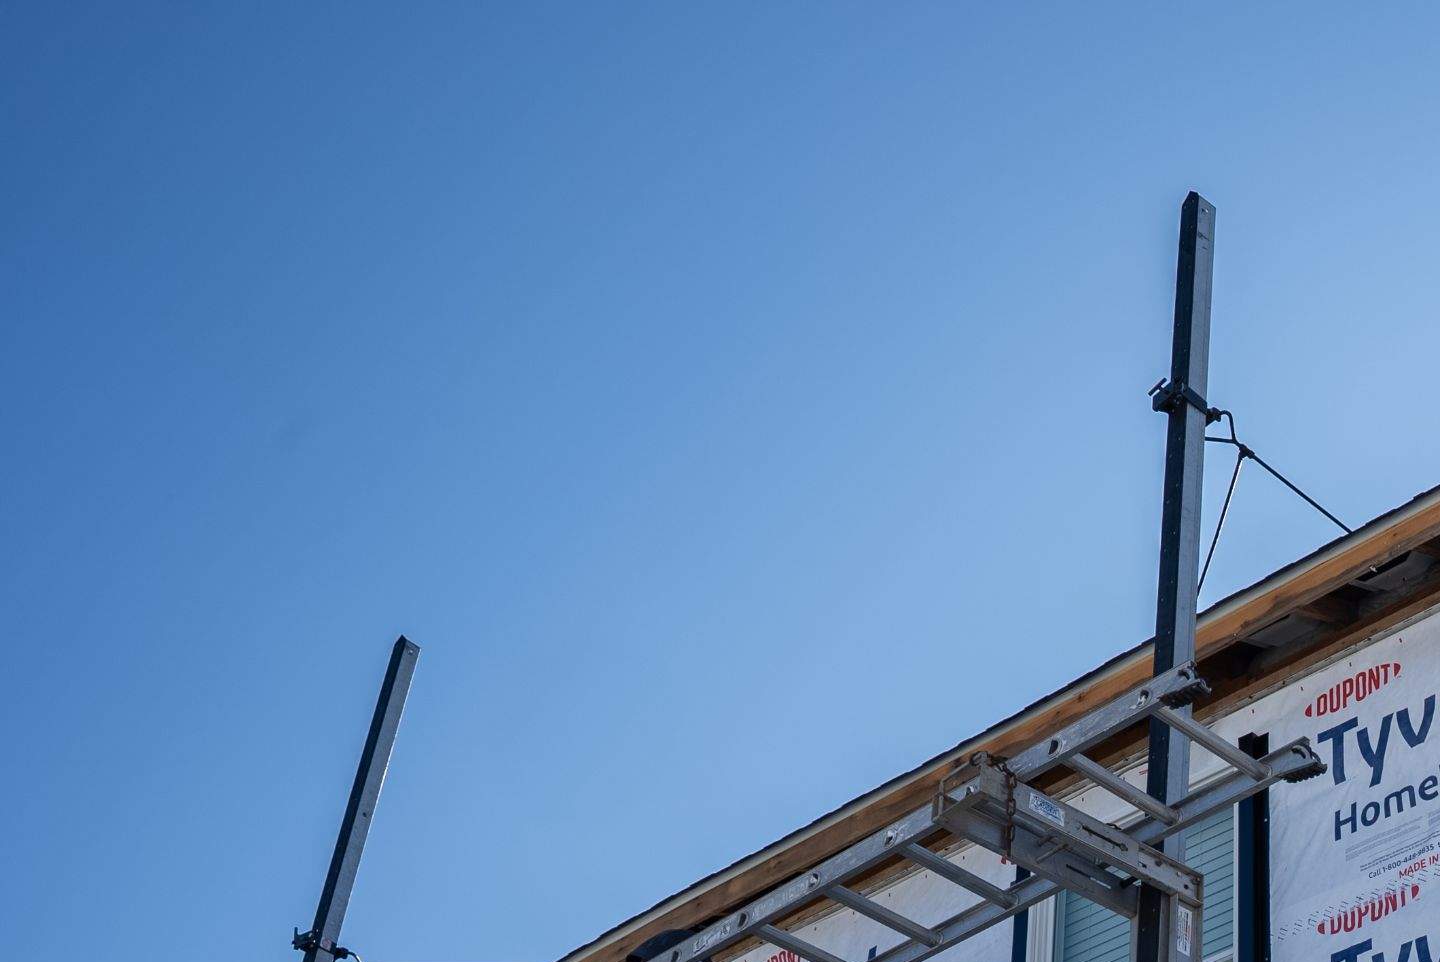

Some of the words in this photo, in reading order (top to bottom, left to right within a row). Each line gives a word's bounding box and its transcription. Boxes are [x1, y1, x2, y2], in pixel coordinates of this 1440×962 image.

[1305, 662, 1401, 717] DUPONT
[1368, 868, 1381, 878] Call
[1399, 859, 1427, 878] MADE
[1429, 854, 1438, 864] IN
